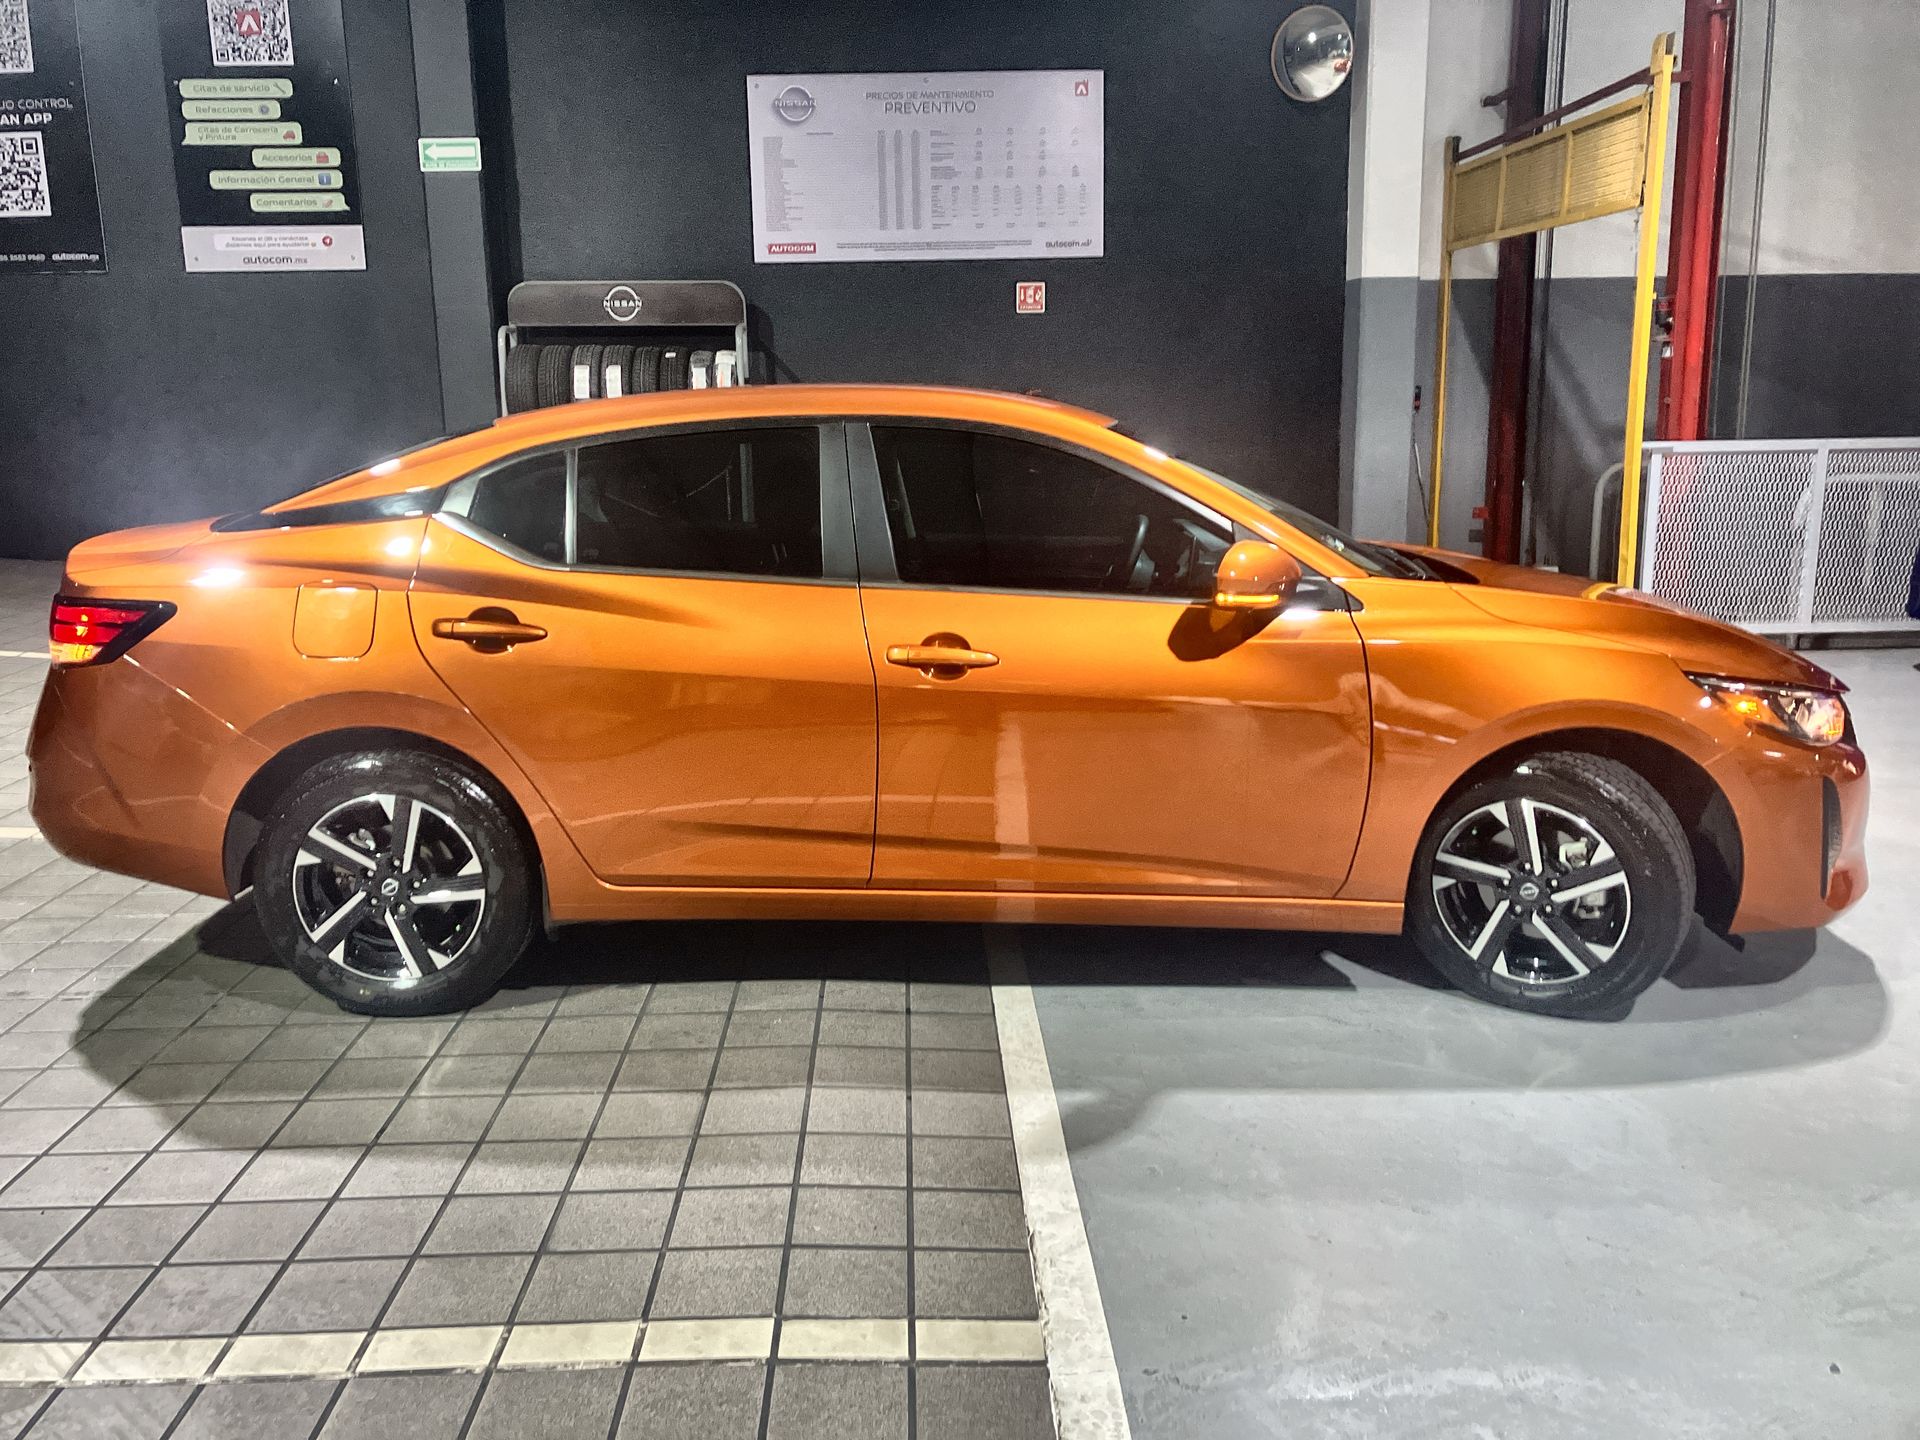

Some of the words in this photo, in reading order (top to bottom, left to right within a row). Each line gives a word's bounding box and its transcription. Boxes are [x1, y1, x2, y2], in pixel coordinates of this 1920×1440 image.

[193, 84, 218, 93] Citas
[219, 84, 232, 92] de
[233, 84, 271, 92] servicio
[865, 91, 904, 100] PRECIOS
[906, 91, 918, 100] DE
[920, 90, 995, 99] MANTENIMIENTO
[17, 98, 74, 110] CONTROL
[884, 100, 977, 114] PREVENTIVO
[195, 105, 254, 114] Refacciones
[23, 112, 53, 125] APP
[197, 126, 220, 134] Citas
[221, 126, 233, 134] de
[205, 133, 238, 141] Pintura
[261, 153, 313, 162] Accesorios
[218, 175, 276, 184] Información
[278, 175, 315, 183] General
[256, 198, 318, 207] Comentarios
[770, 244, 815, 252] AUTOCOM
[242, 255, 308, 265] autocom.mx
